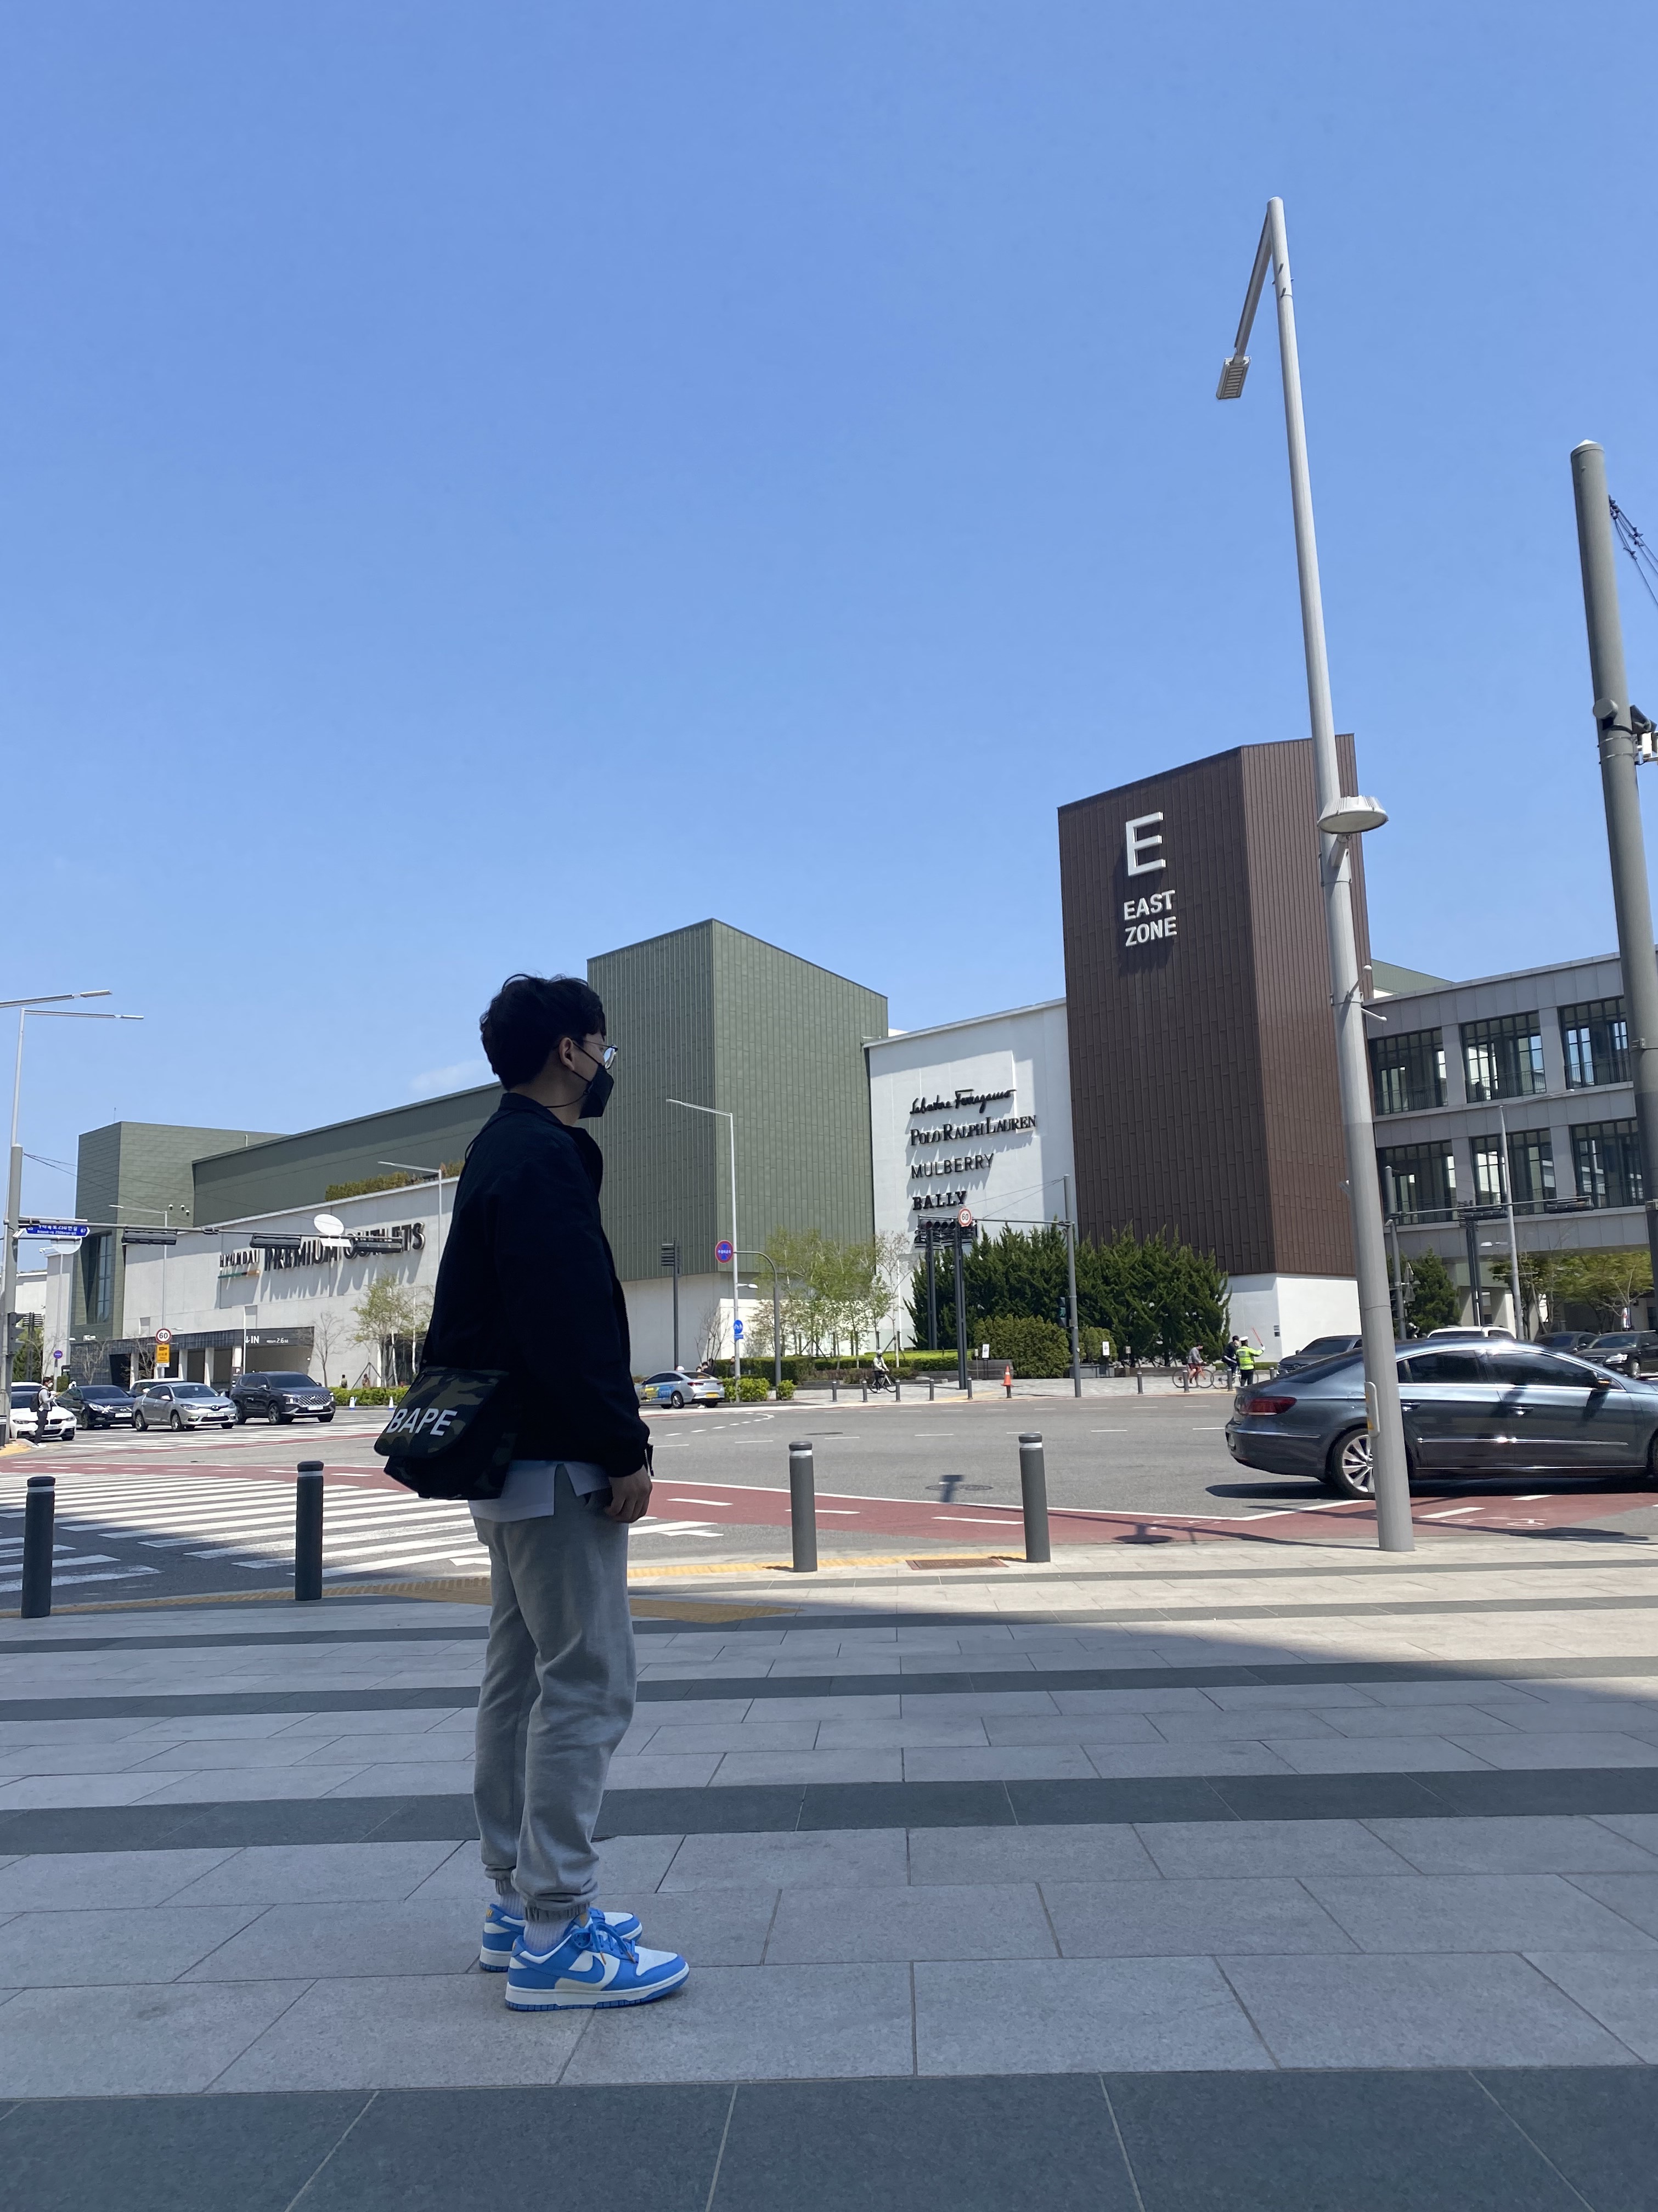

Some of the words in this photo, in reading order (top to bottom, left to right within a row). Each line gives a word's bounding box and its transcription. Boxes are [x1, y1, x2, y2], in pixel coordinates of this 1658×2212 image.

[1125, 811, 1166, 877] E
[1124, 889, 1176, 921] EAST
[1125, 916, 1177, 947] ZONE
[911, 1153, 994, 1179] MULBERRY
[912, 1190, 967, 1211] BALLY
[219, 1249, 260, 1268] HYUNDAI
[251, 1335, 260, 1344] IN
[386, 1408, 458, 1436] BAPE
